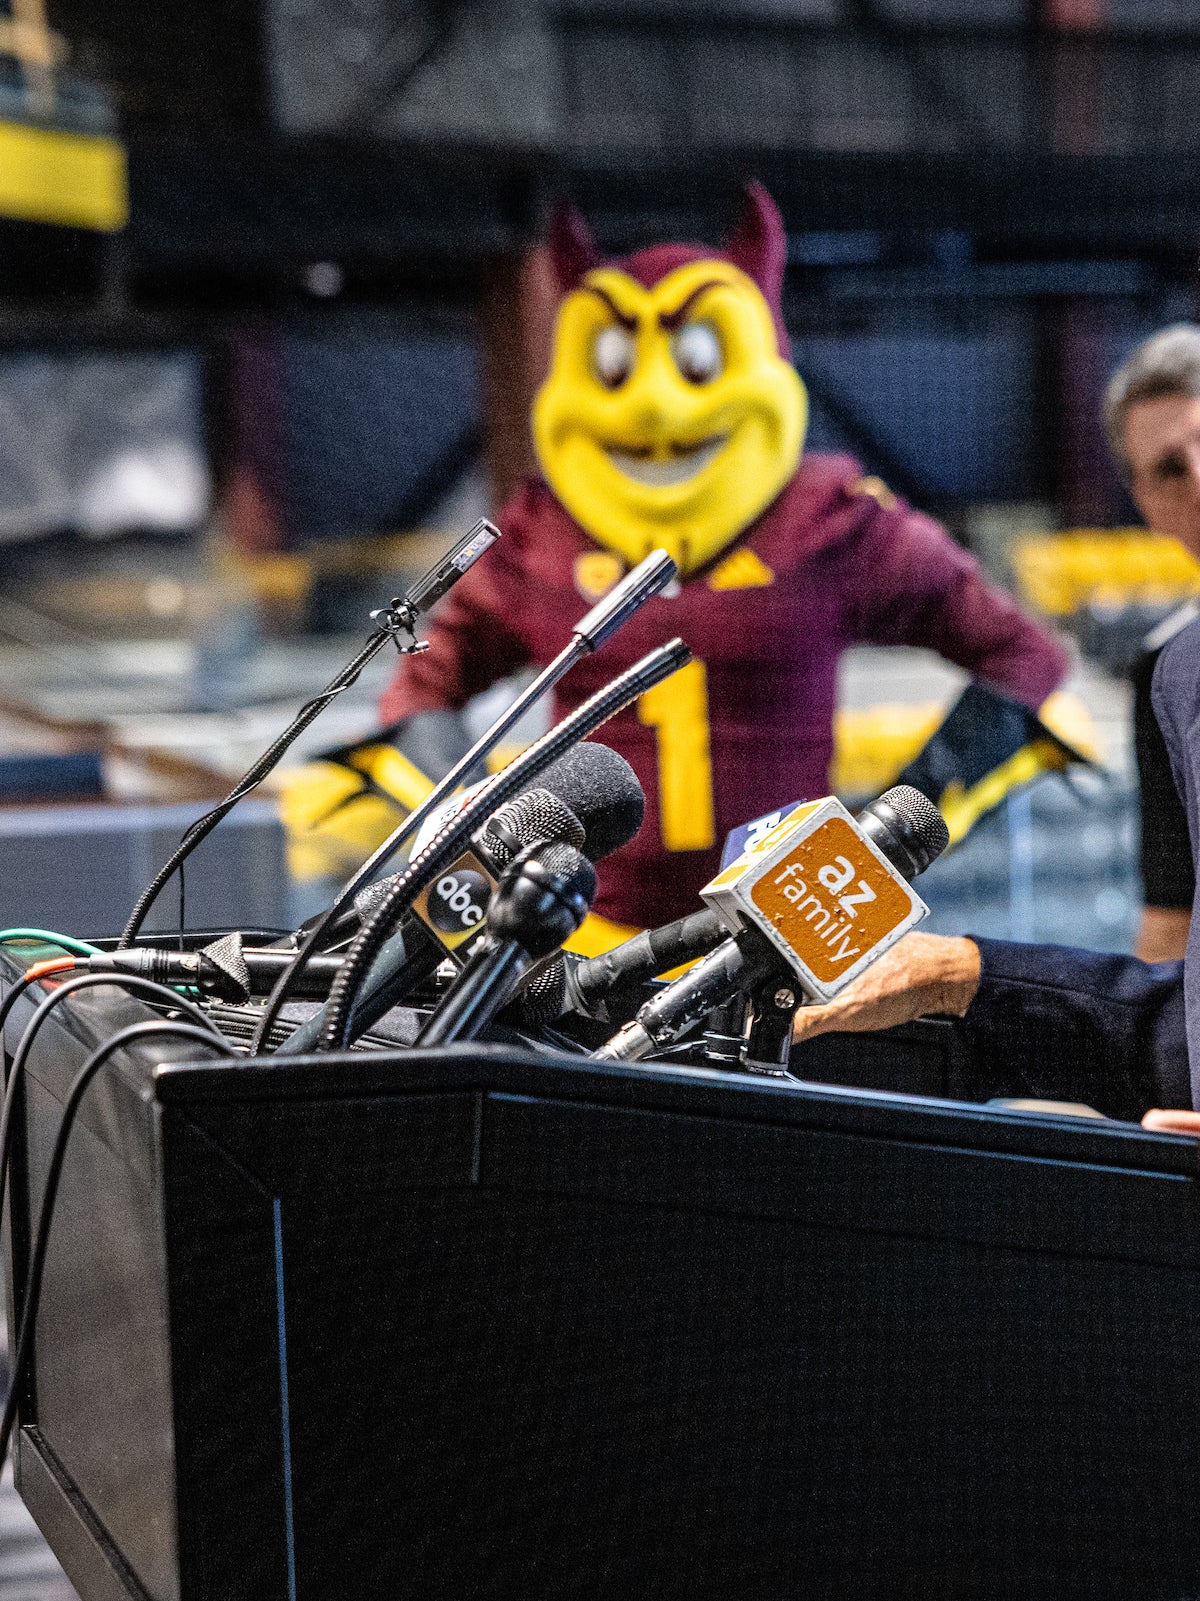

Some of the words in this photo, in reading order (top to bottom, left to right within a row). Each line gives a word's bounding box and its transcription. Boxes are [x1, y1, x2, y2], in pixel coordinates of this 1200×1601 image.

[638, 656, 714, 850] 1
[437, 876, 483, 926] abc
[774, 862, 860, 962] family
[817, 855, 877, 919] az
